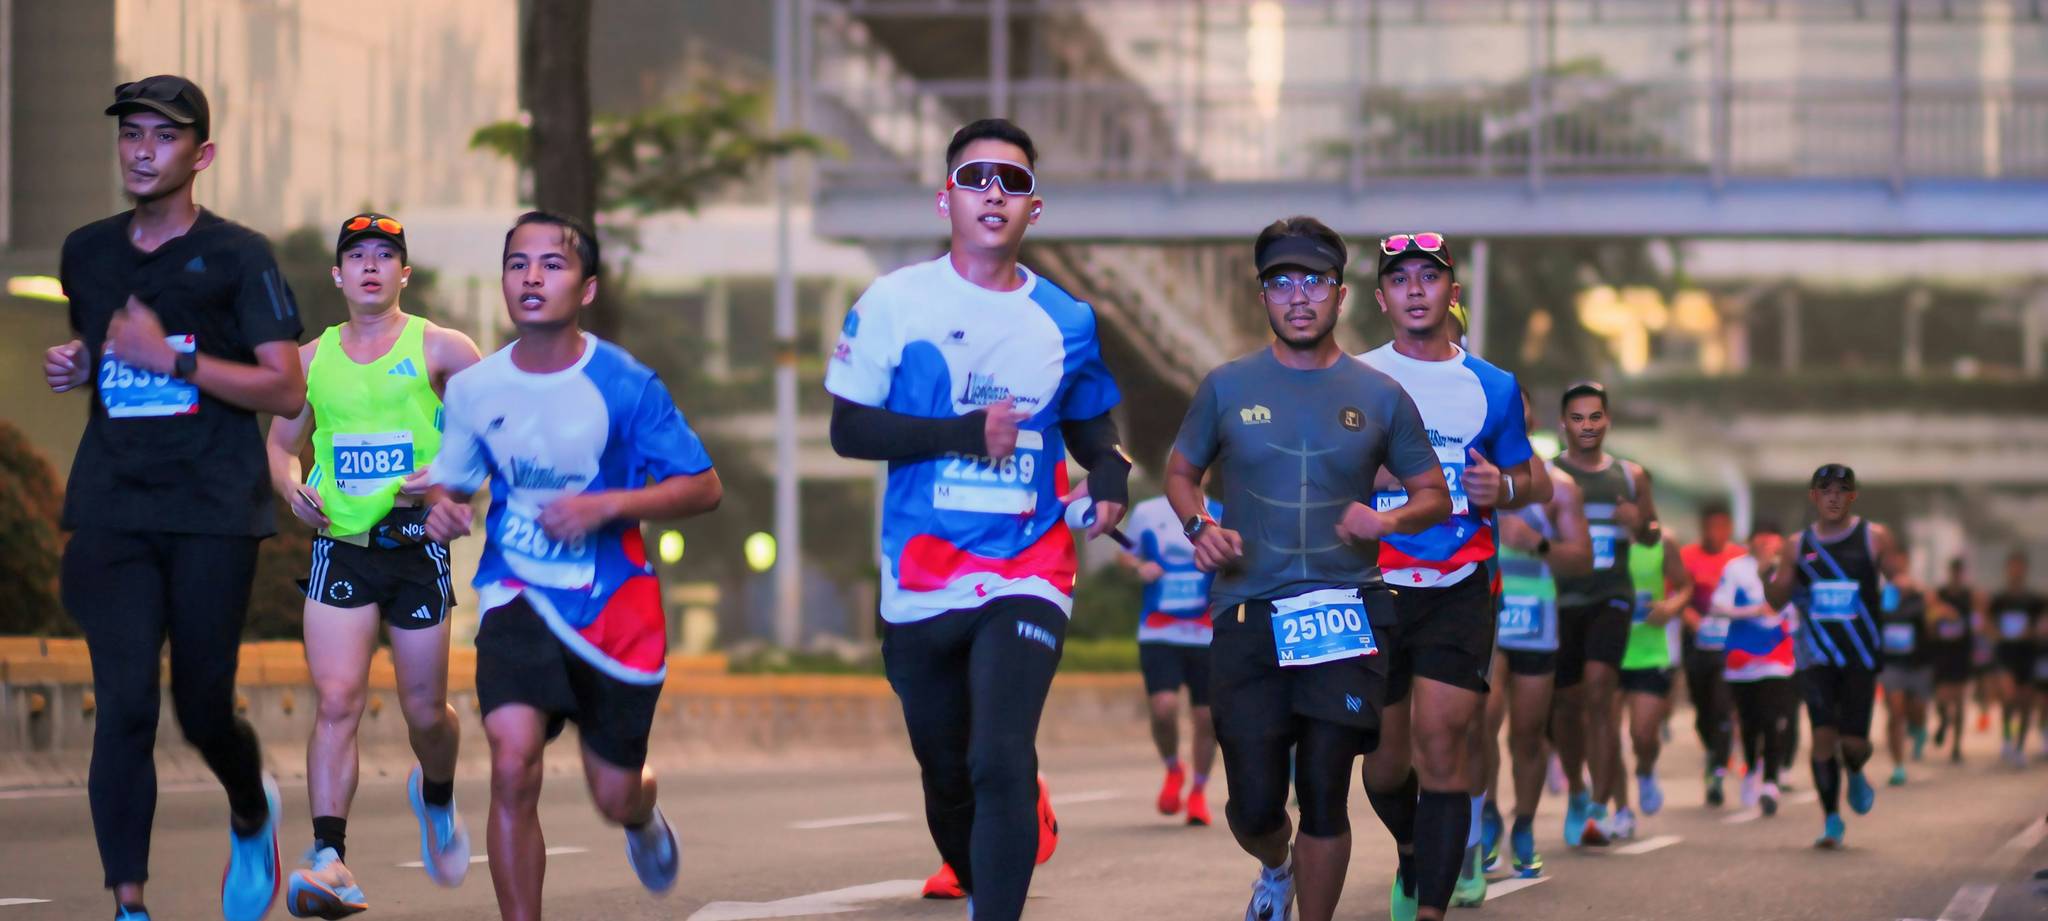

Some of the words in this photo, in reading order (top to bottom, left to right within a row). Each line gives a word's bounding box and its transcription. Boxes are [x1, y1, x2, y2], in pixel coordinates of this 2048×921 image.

[340, 449, 405, 474] 21082
[943, 451, 1035, 484] 22269
[337, 481, 346, 489] M
[938, 487, 950, 497] M
[1380, 498, 1391, 508] M
[1283, 608, 1361, 644] 25100
[1280, 650, 1294, 661] M
